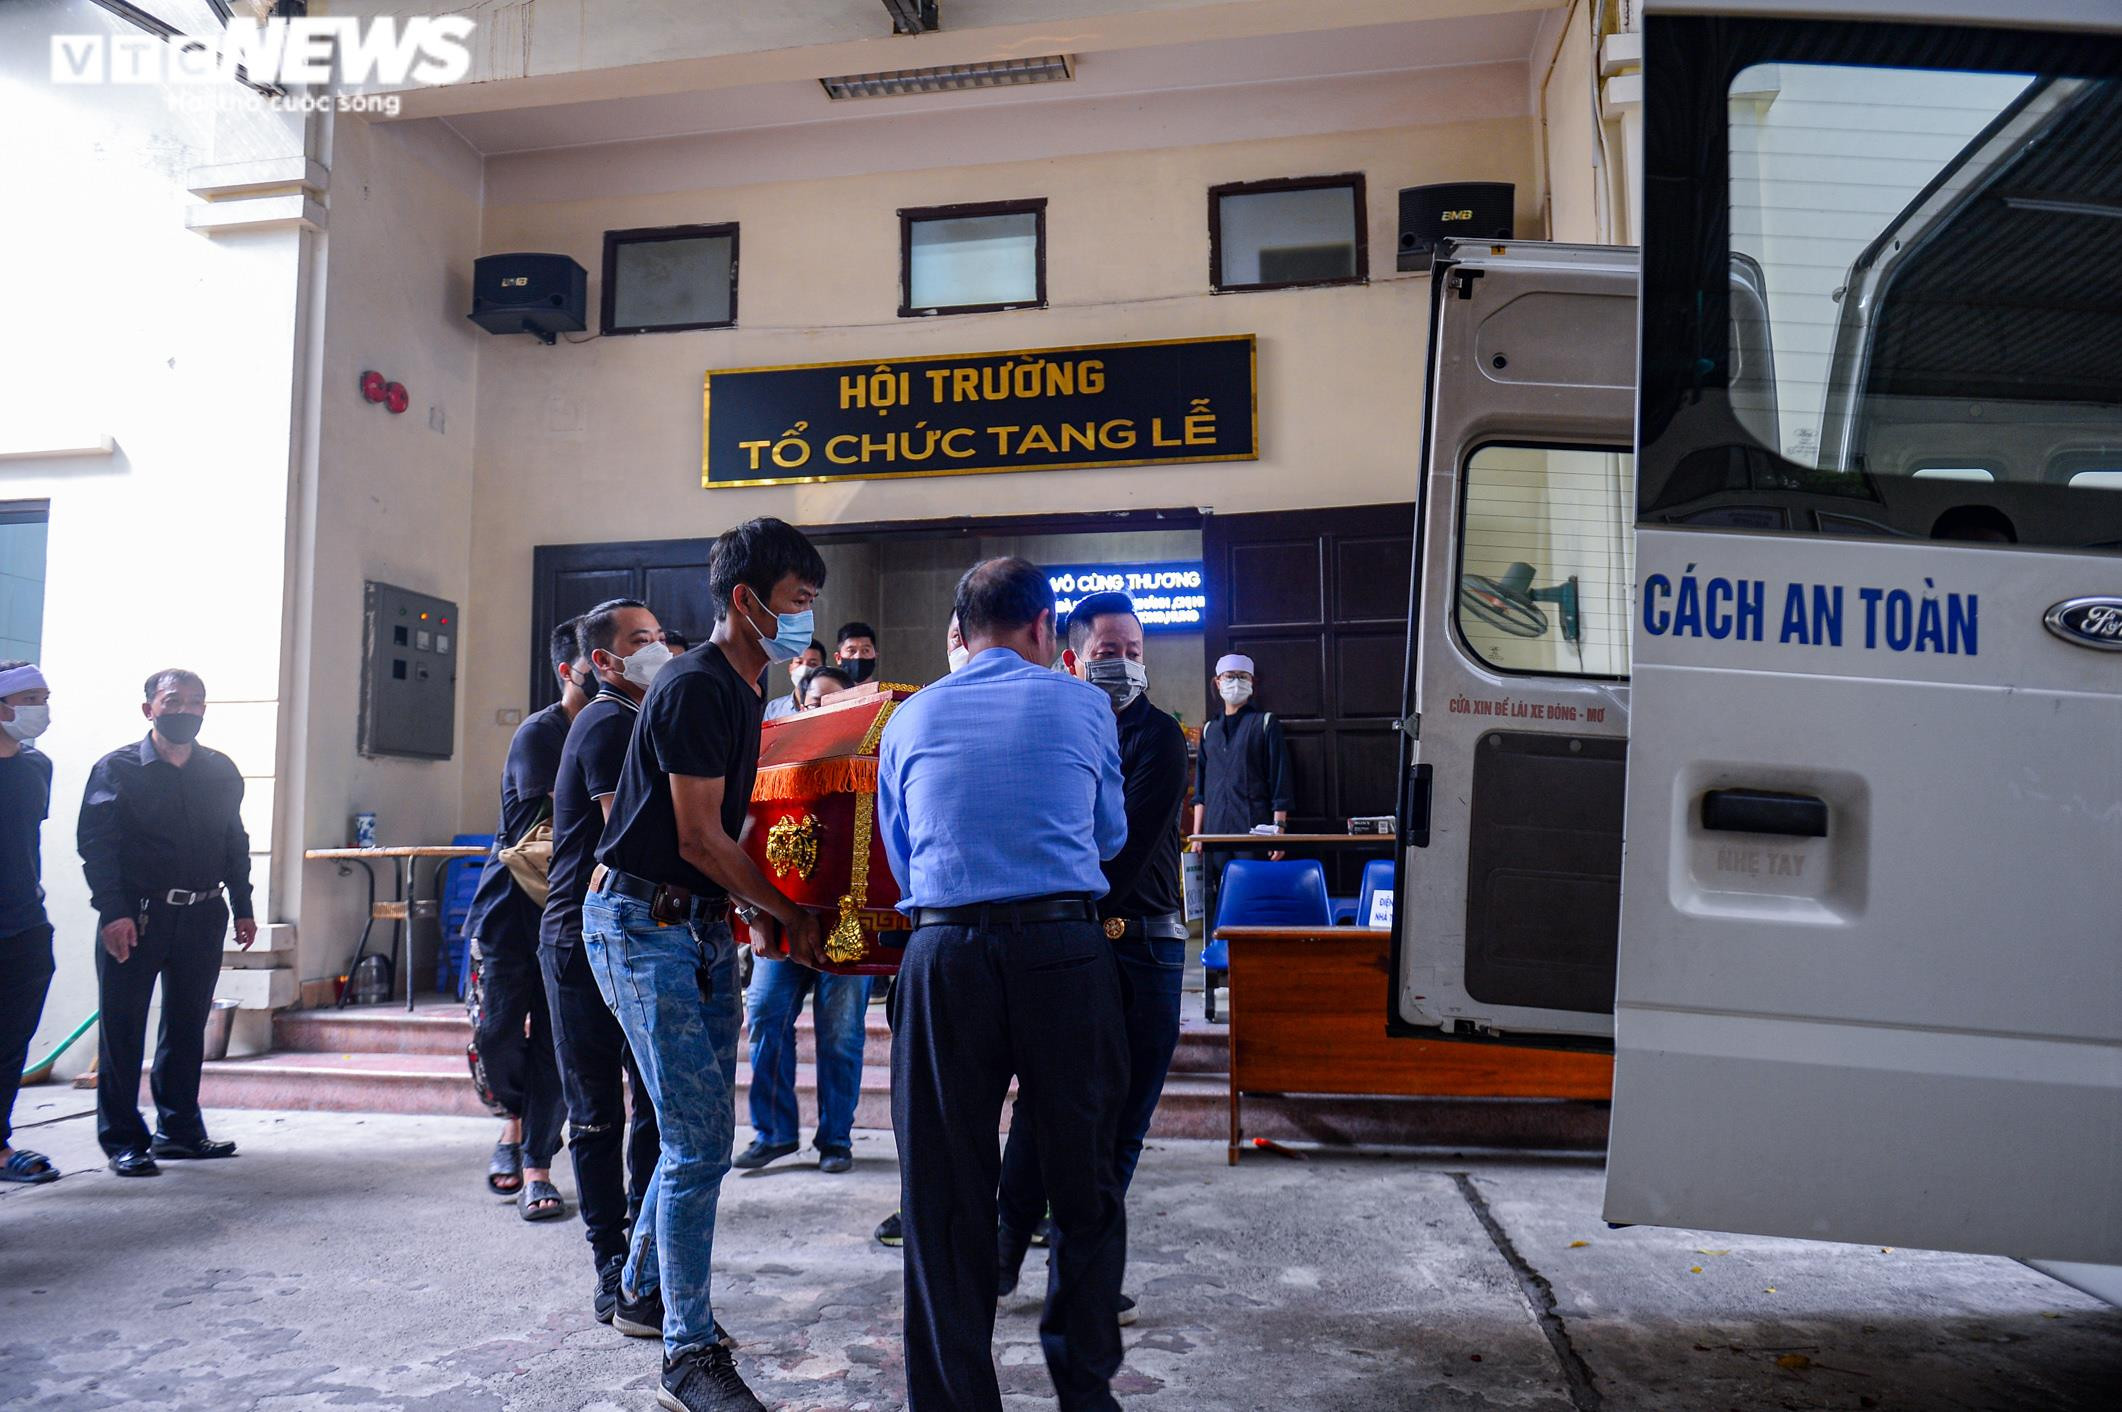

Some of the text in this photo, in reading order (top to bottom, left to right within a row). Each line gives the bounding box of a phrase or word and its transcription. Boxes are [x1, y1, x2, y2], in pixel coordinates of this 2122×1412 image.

[1441, 210, 1473, 221] BMB
[839, 354, 1105, 416] HỘI TRƯỜNG
[738, 397, 1217, 470] TỔ CHỨC TANG LỄ
[1049, 573, 1076, 593] VÔ
[1076, 572, 1125, 592] CÙNG
[1643, 563, 1978, 656] CÁCH AN TOÀN
[1472, 700, 1492, 715] XIN
[1530, 703, 1544, 719] XE
[1767, 852, 1806, 877] TAY
